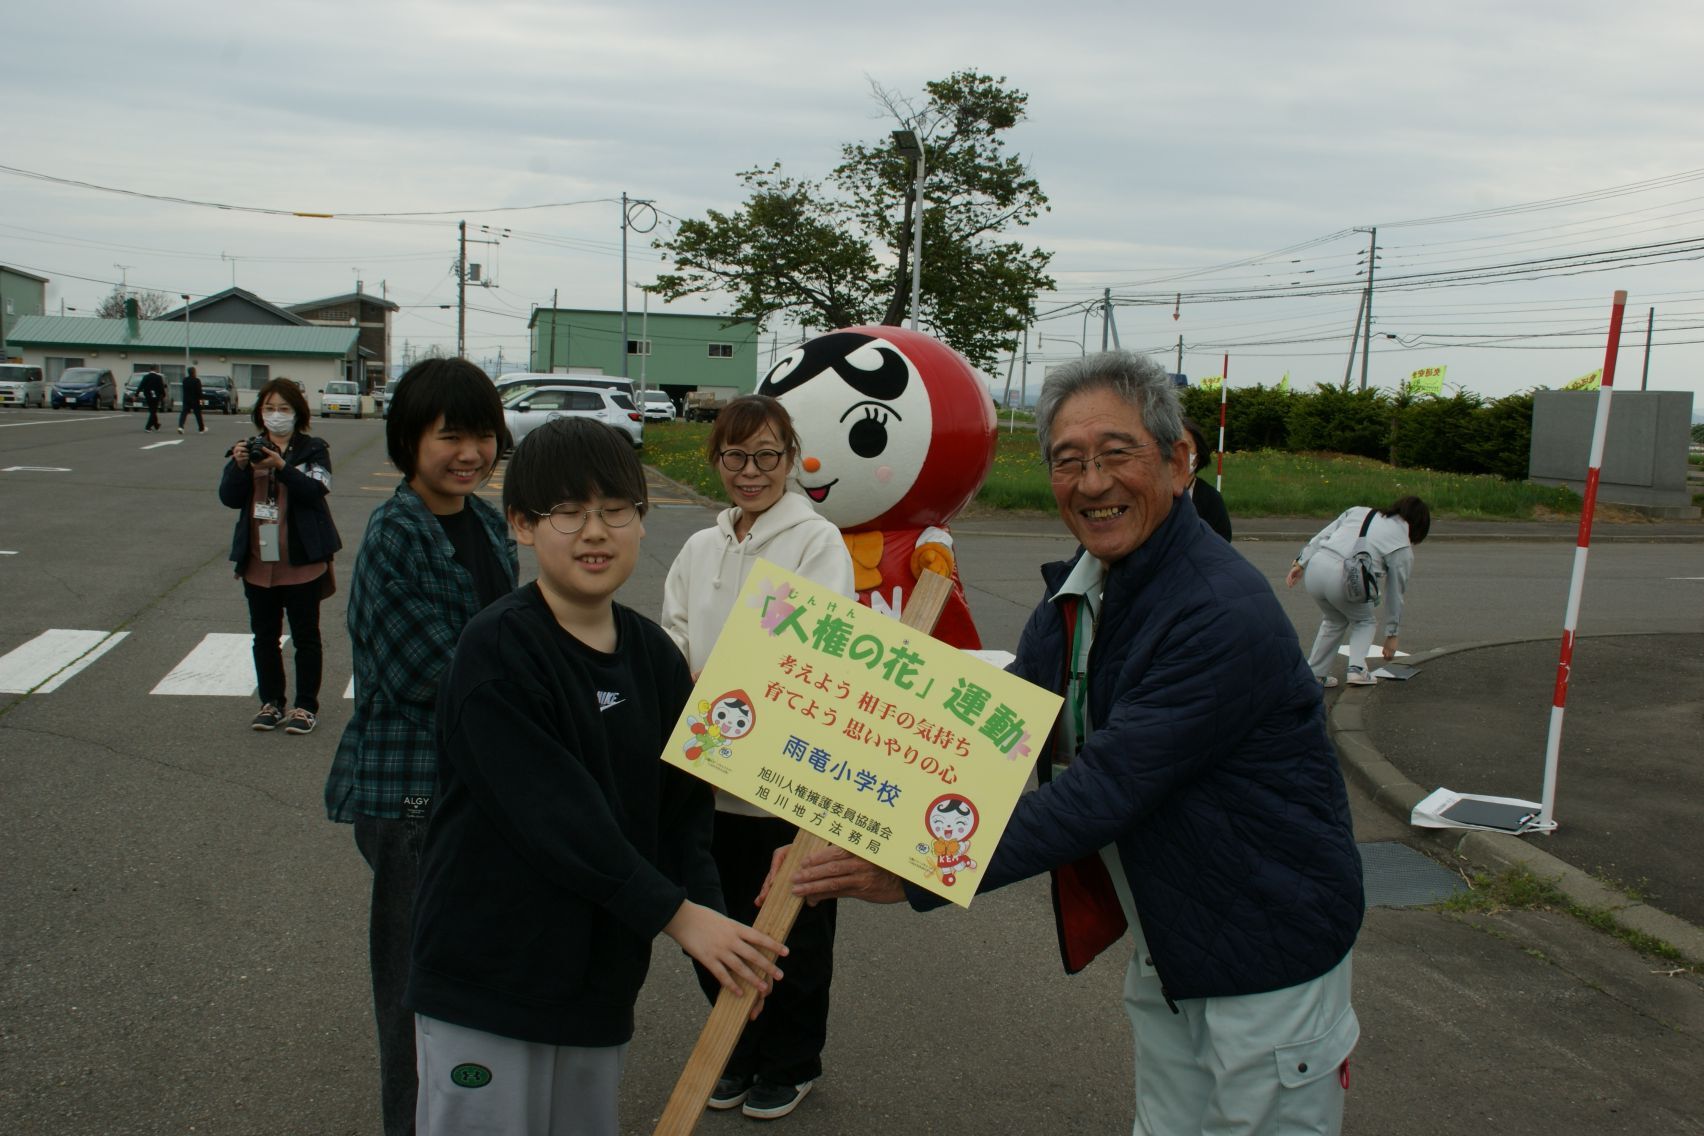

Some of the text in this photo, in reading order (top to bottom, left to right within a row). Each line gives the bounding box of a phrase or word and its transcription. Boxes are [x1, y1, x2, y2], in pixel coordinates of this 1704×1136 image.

[787, 588, 856, 619] じんけん
[764, 680, 958, 785] 育てよう 思いやりの心
[778, 655, 971, 758] 考えよう 相手の気持ち
[943, 677, 1026, 754] 運動
[403, 796, 431, 805] ALGY
[757, 766, 893, 841] 旭川人権擁護委員協議会
[782, 734, 902, 808] 雨竜小学校
[755, 785, 881, 855] 旭川地方法務局
